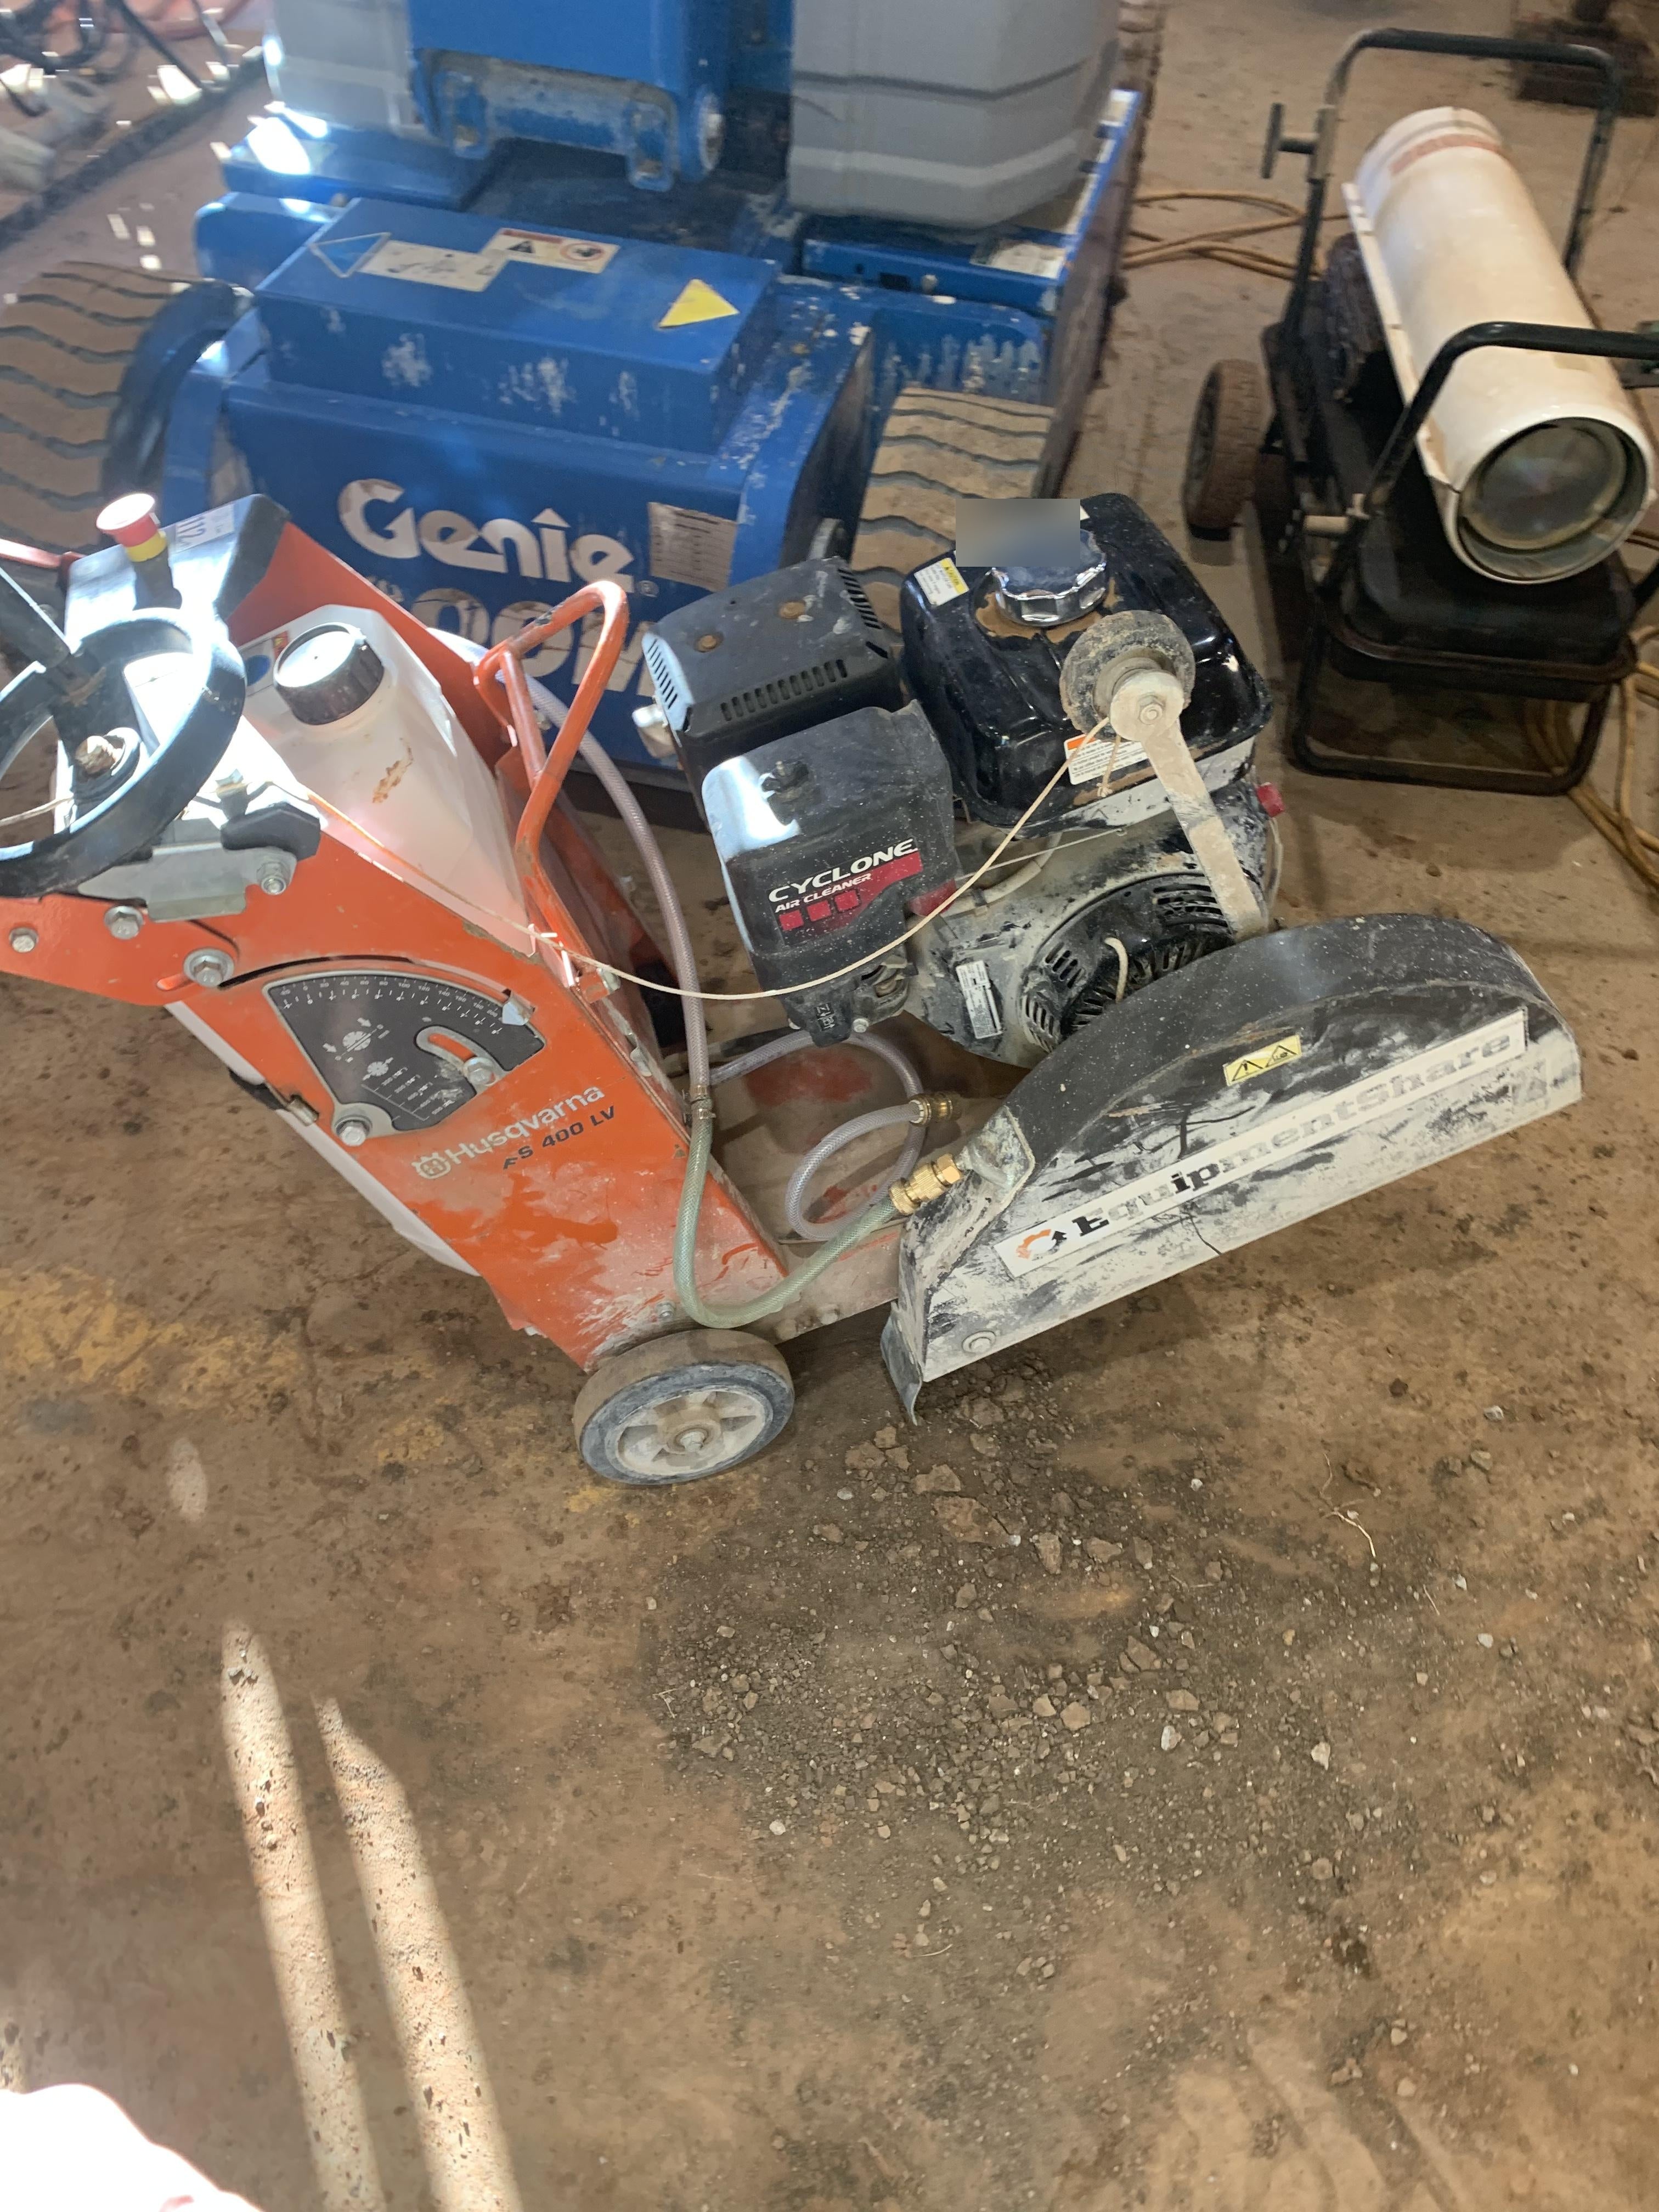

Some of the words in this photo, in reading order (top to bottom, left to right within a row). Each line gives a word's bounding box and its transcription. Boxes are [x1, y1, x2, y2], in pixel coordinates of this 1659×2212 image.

[338, 478, 634, 594] Genie
[768, 838, 918, 902] CYCLONE
[775, 900, 800, 913] AIR
[803, 873, 871, 903] CLEANER
[444, 1085, 606, 1164] Husqvarna
[503, 1146, 534, 1170] FS
[542, 1122, 584, 1148] 400
[590, 1105, 615, 1127] LV
